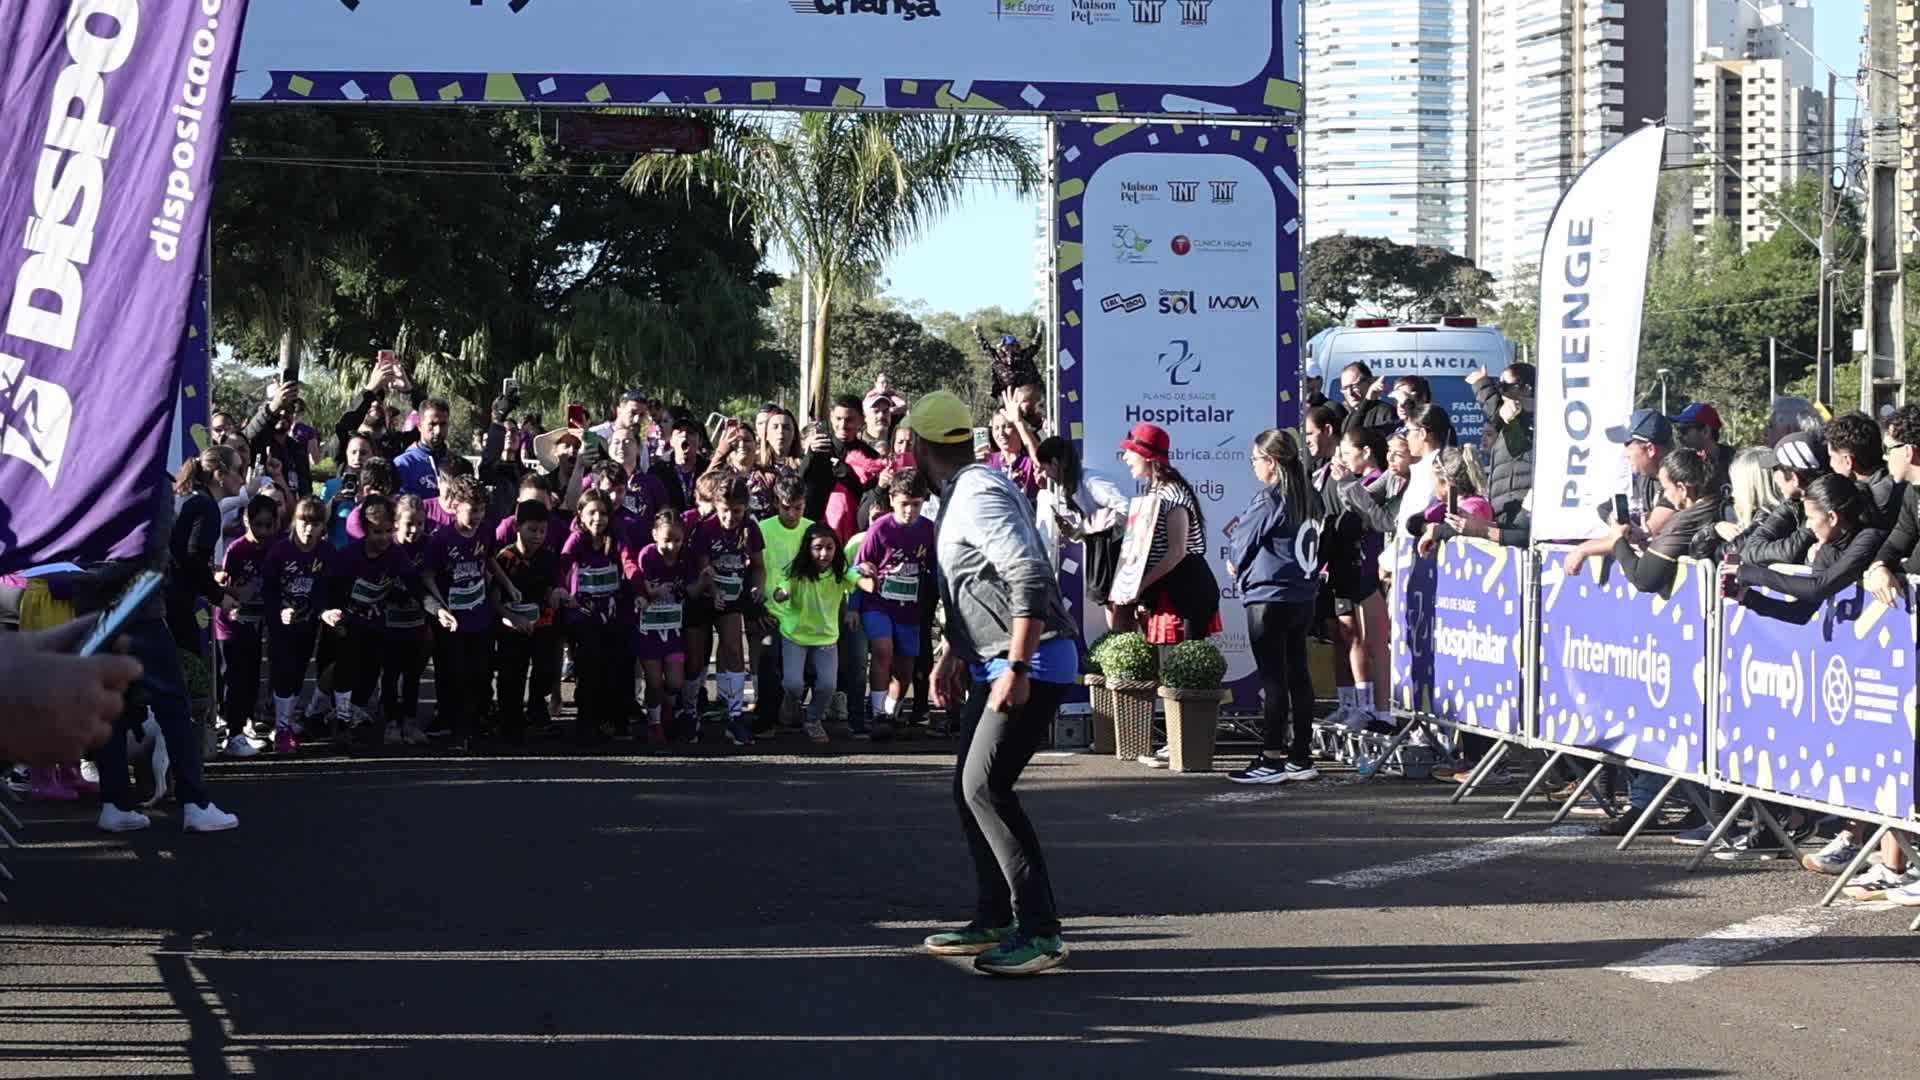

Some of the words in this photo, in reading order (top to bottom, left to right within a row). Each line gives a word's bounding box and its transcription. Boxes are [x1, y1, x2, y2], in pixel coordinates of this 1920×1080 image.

[1128, 0, 1167, 23] TNT
[1176, 0, 1213, 20] TNT
[1120, 181, 1158, 191] Maison
[1167, 181, 1200, 201] TNT
[1208, 181, 1238, 200] TNT
[1560, 216, 1594, 509] PROTENGE
[1143, 393, 1172, 401] PLANO
[1174, 393, 1185, 401] DE
[1451, 402, 1481, 412] FAÇA
[1125, 404, 1235, 425] Hospitalar
[1450, 415, 1460, 423] O
[1461, 415, 1484, 423] SEU
[1135, 479, 1225, 501] Inidia
[1431, 616, 1508, 666] Hospitalar
[1562, 625, 1672, 710] Intermidia
